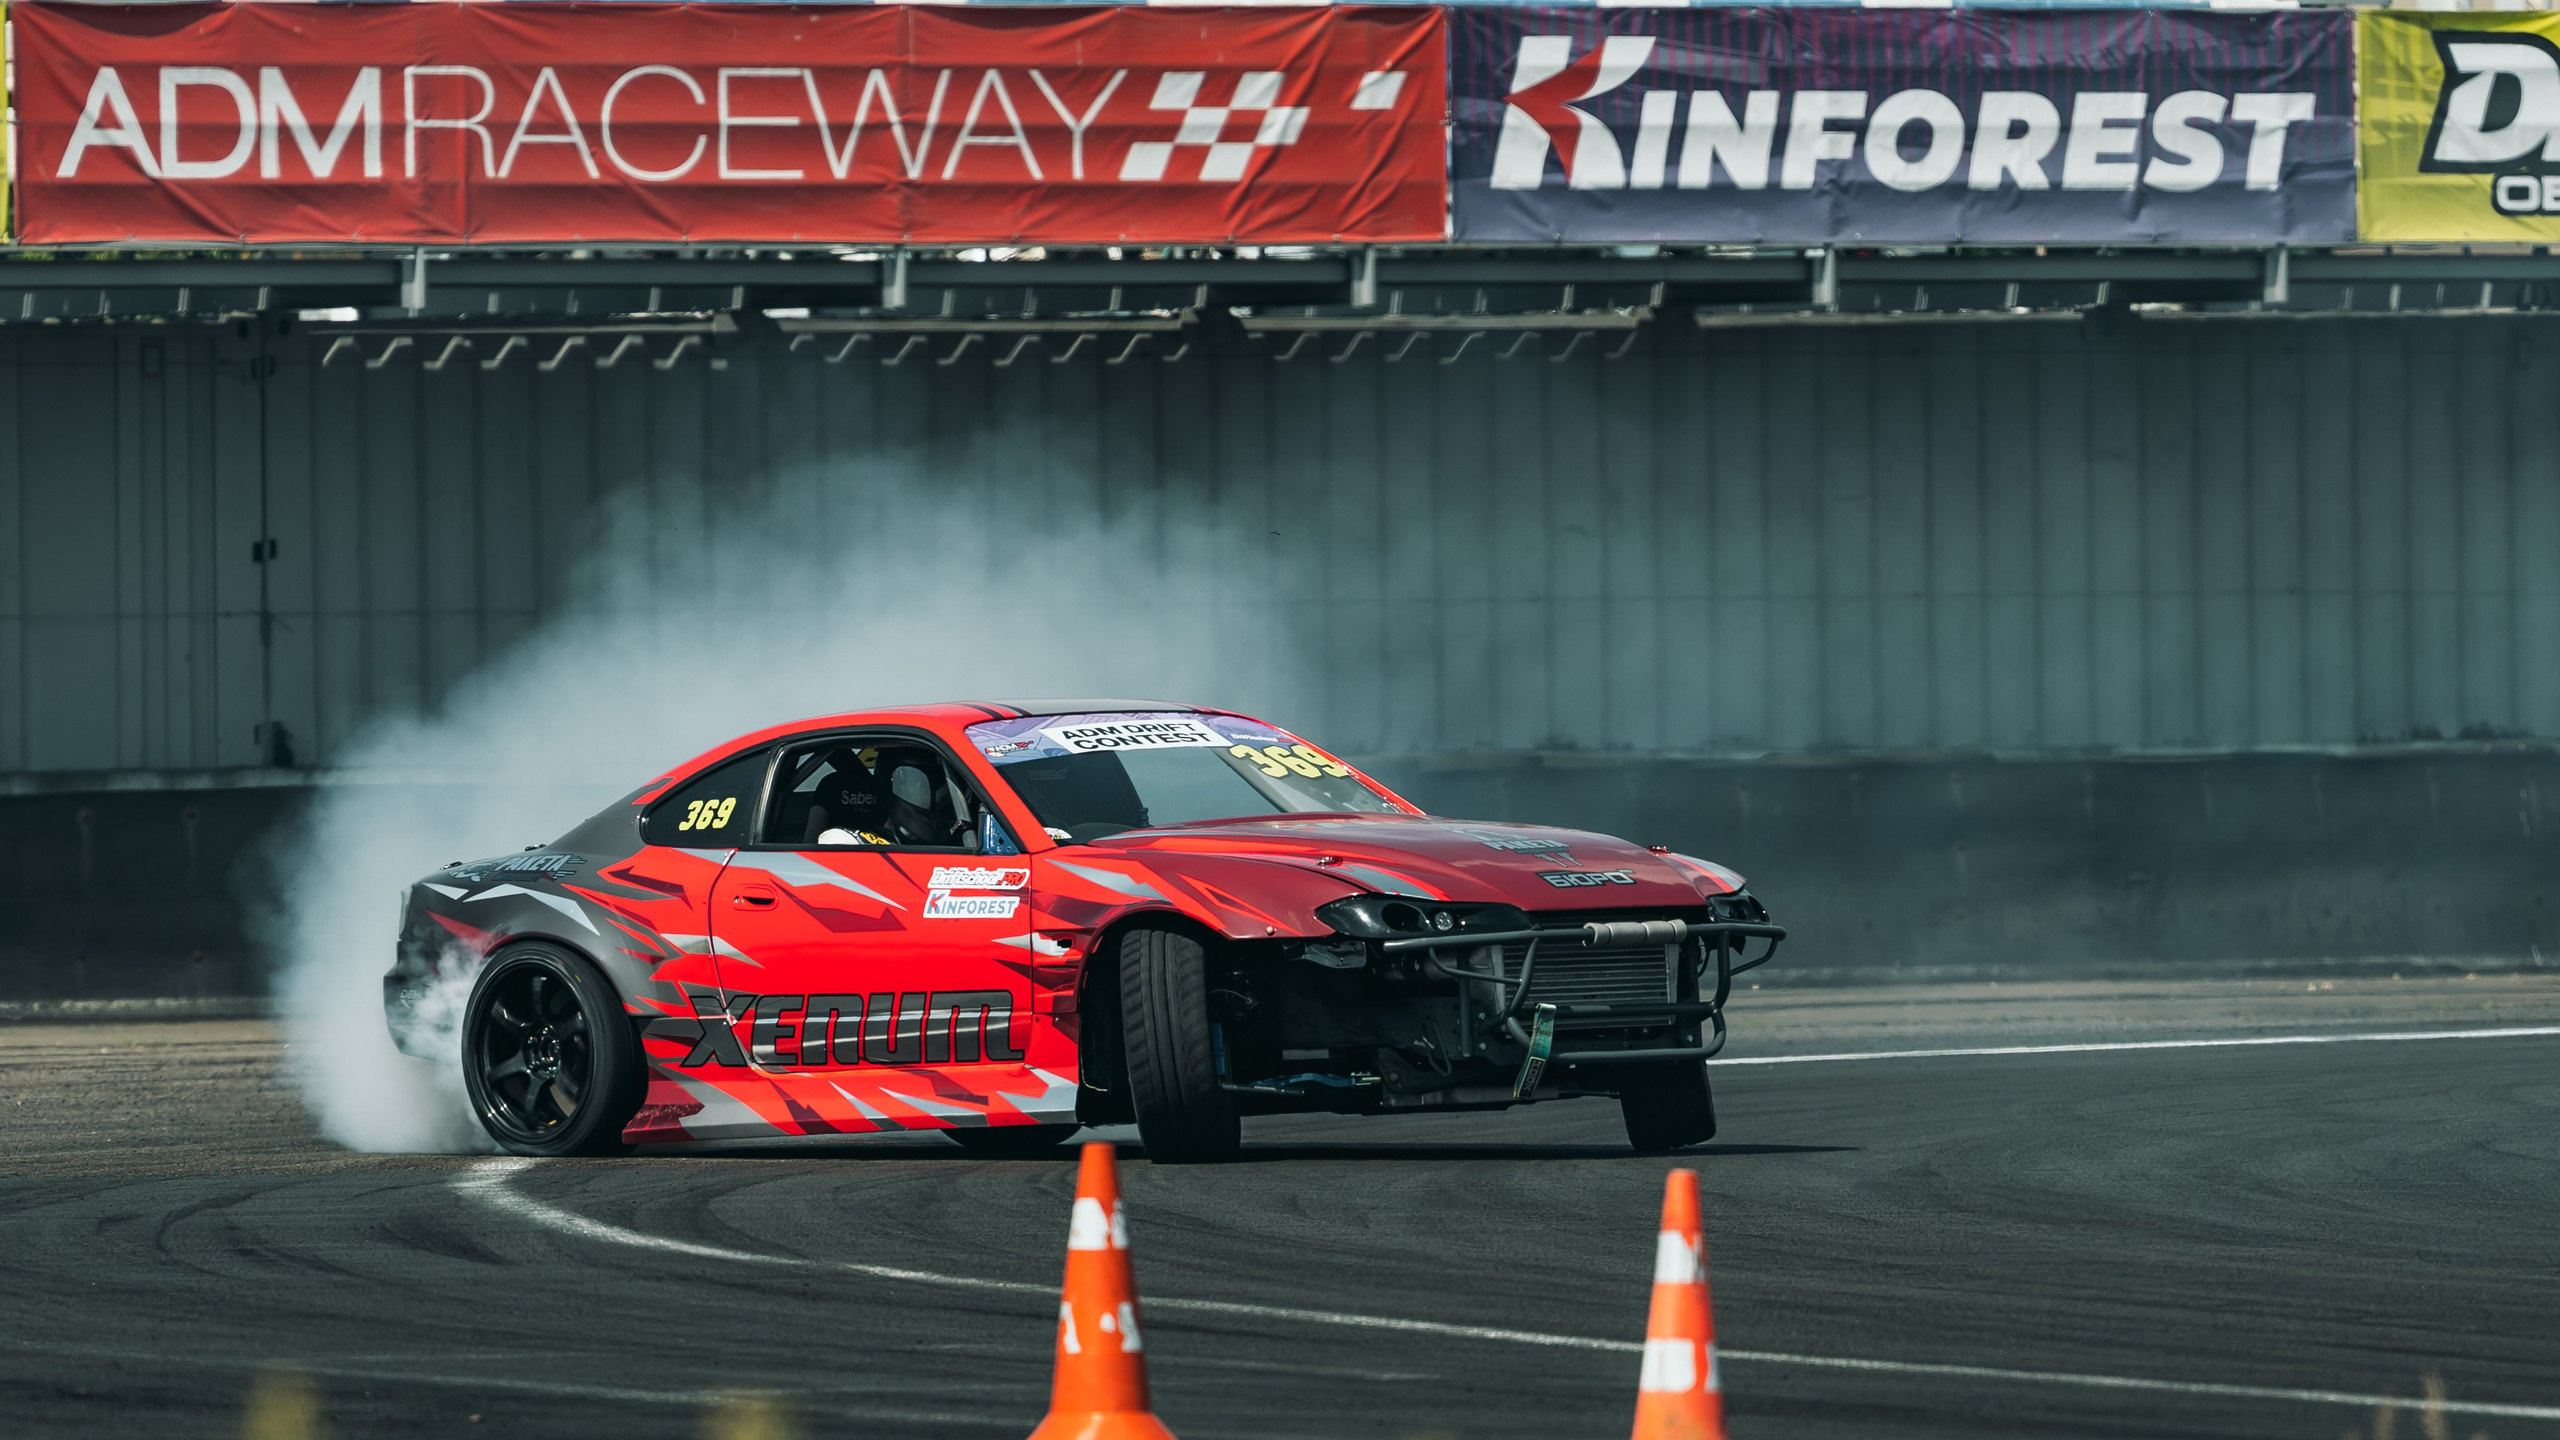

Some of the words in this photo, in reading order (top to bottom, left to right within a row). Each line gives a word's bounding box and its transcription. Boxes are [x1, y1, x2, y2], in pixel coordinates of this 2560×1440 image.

[1489, 35, 2315, 190] KINFOREST
[2433, 42, 2560, 163] D
[1062, 726, 1123, 740] ADM
[1122, 723, 1197, 734] DRIFT
[1073, 733, 1212, 749] CONTEST
[1229, 744, 1349, 778] 369
[678, 797, 737, 831] 369
[1543, 872, 1636, 888] БЮРО
[926, 893, 1016, 914] KINFOREST
[679, 990, 1026, 1068] XENUM
